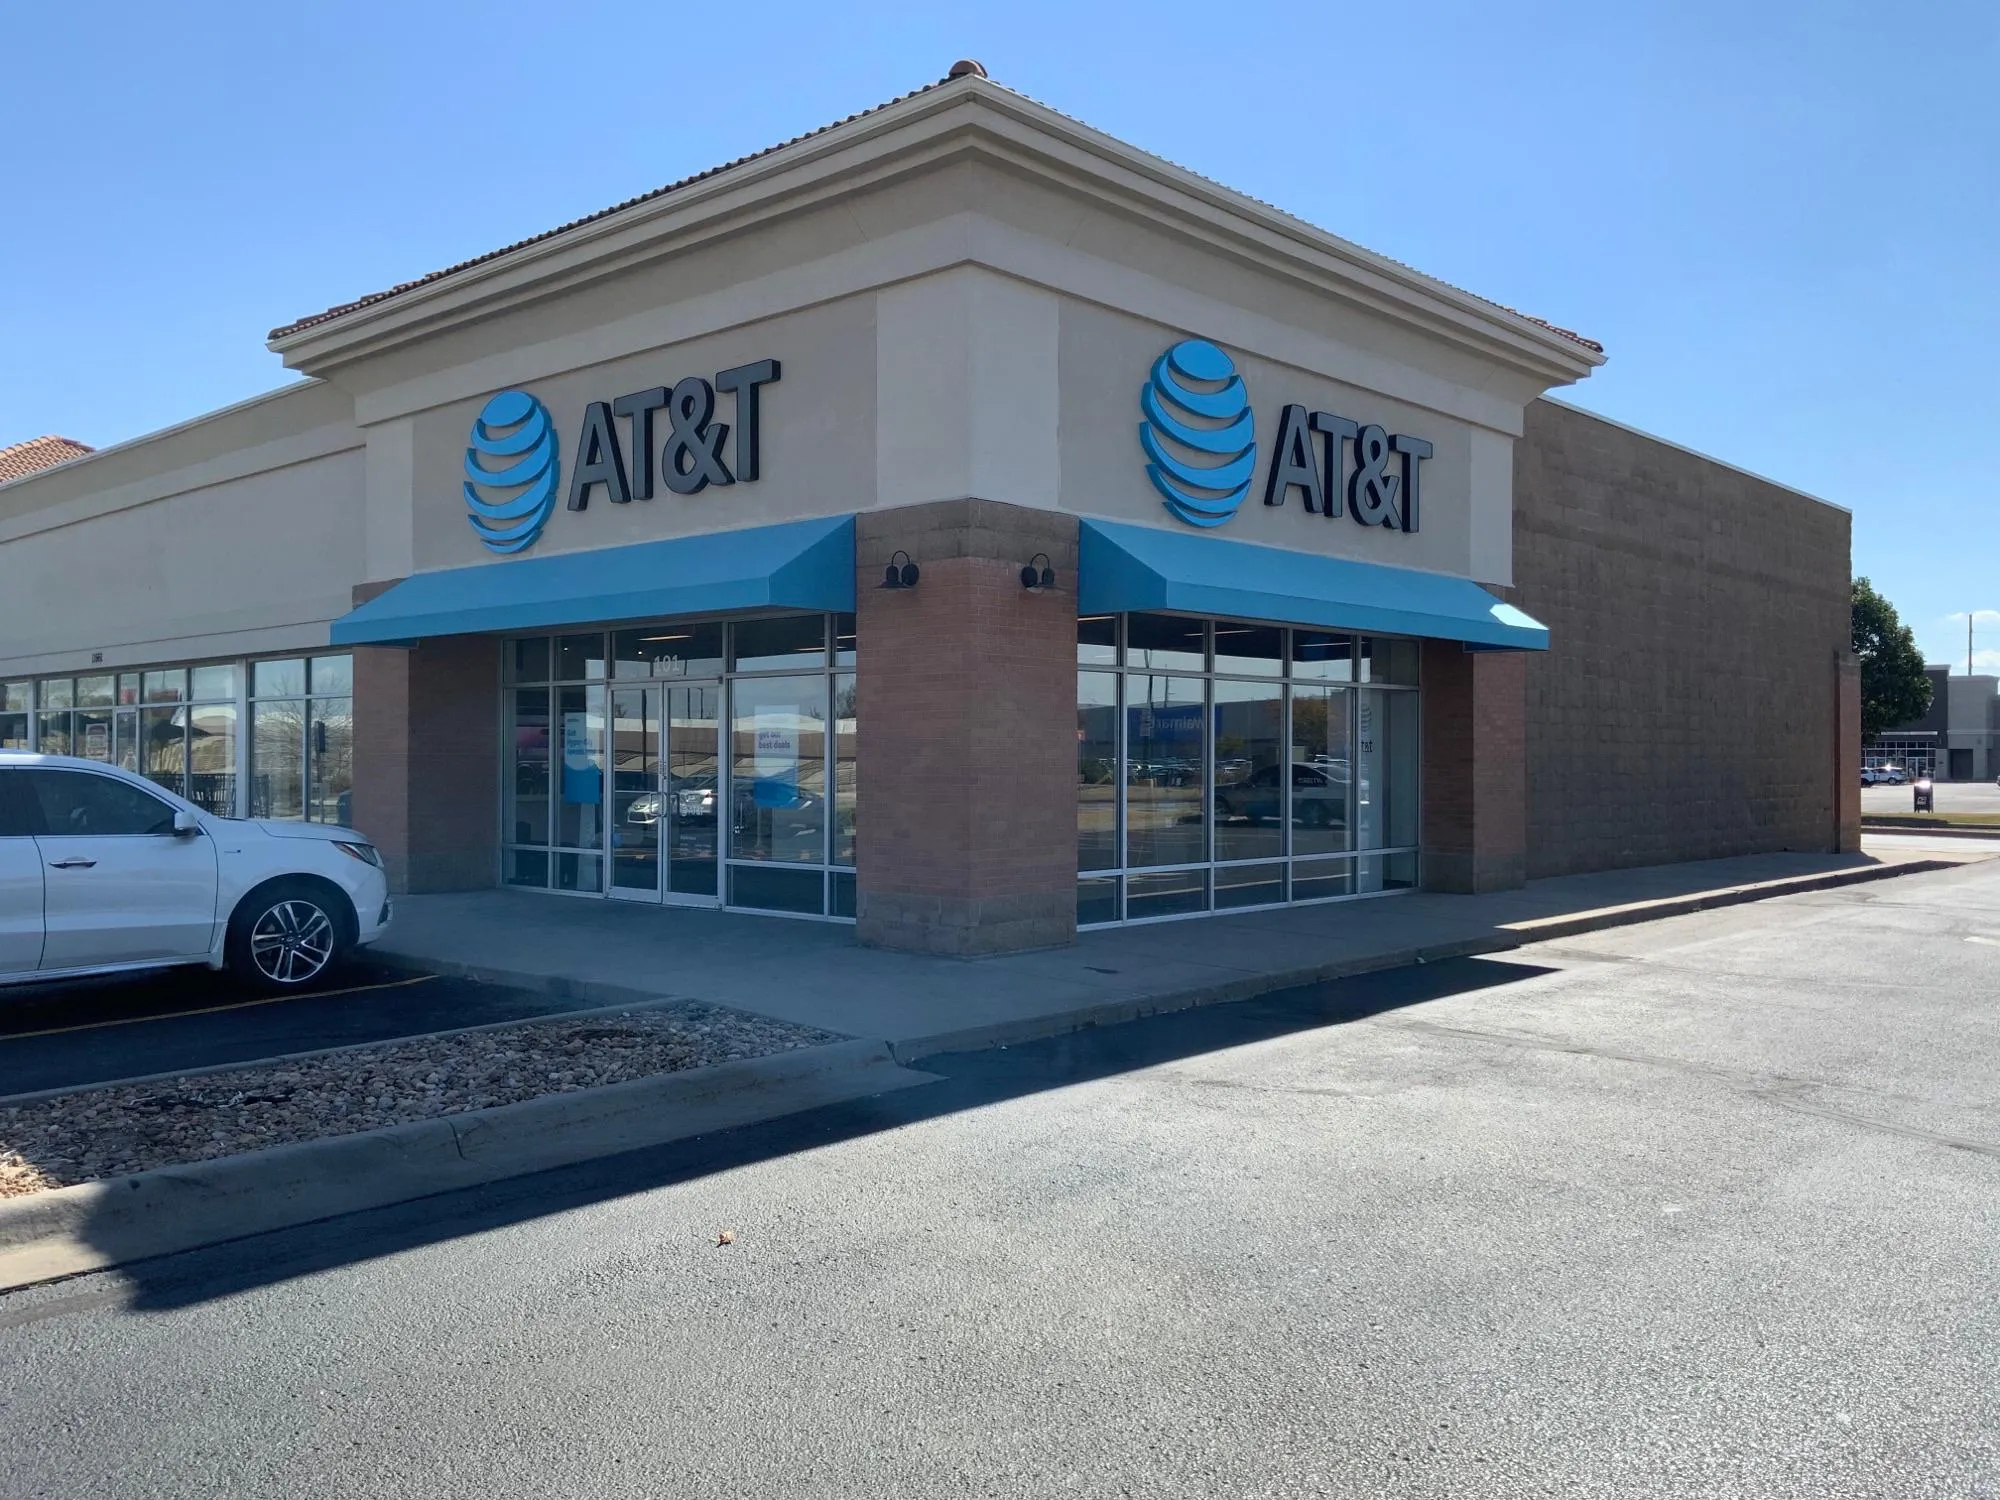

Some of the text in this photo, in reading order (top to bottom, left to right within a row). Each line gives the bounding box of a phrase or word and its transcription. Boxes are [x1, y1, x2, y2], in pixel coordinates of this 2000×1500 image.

[567, 359, 781, 511] AT&T
[1264, 404, 1433, 533] AT&T
[654, 654, 680, 673] 101
